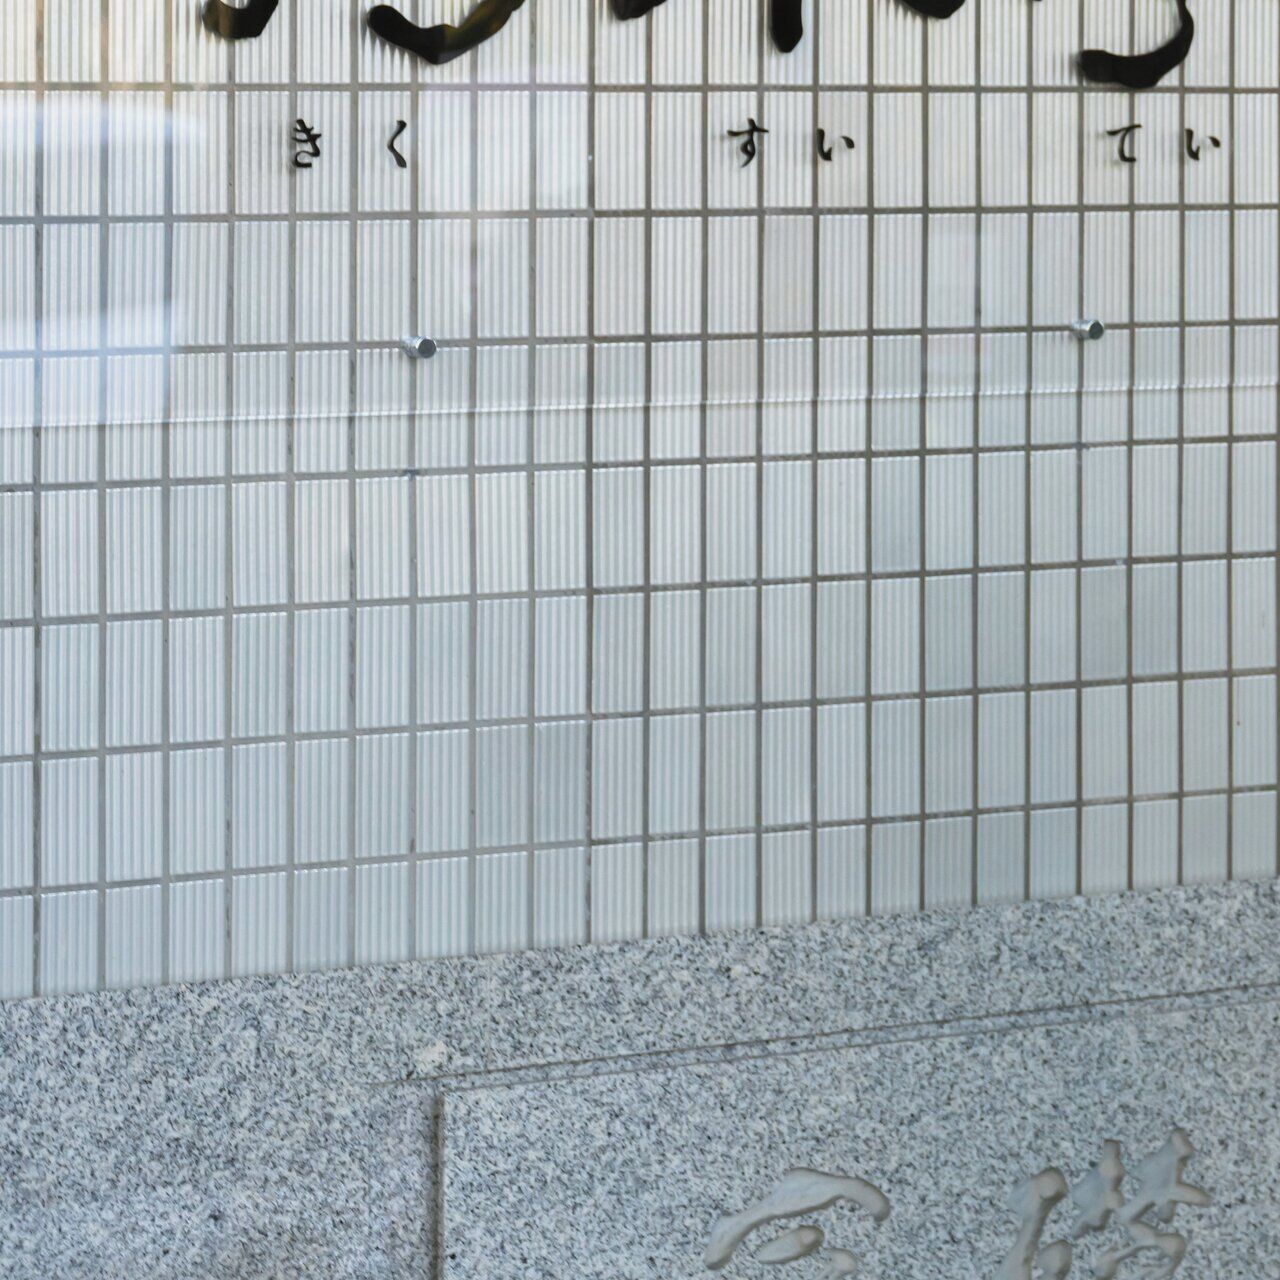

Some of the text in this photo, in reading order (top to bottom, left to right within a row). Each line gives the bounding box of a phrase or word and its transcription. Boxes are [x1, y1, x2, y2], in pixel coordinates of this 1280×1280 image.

[290, 119, 1221, 168] きく すい てい
